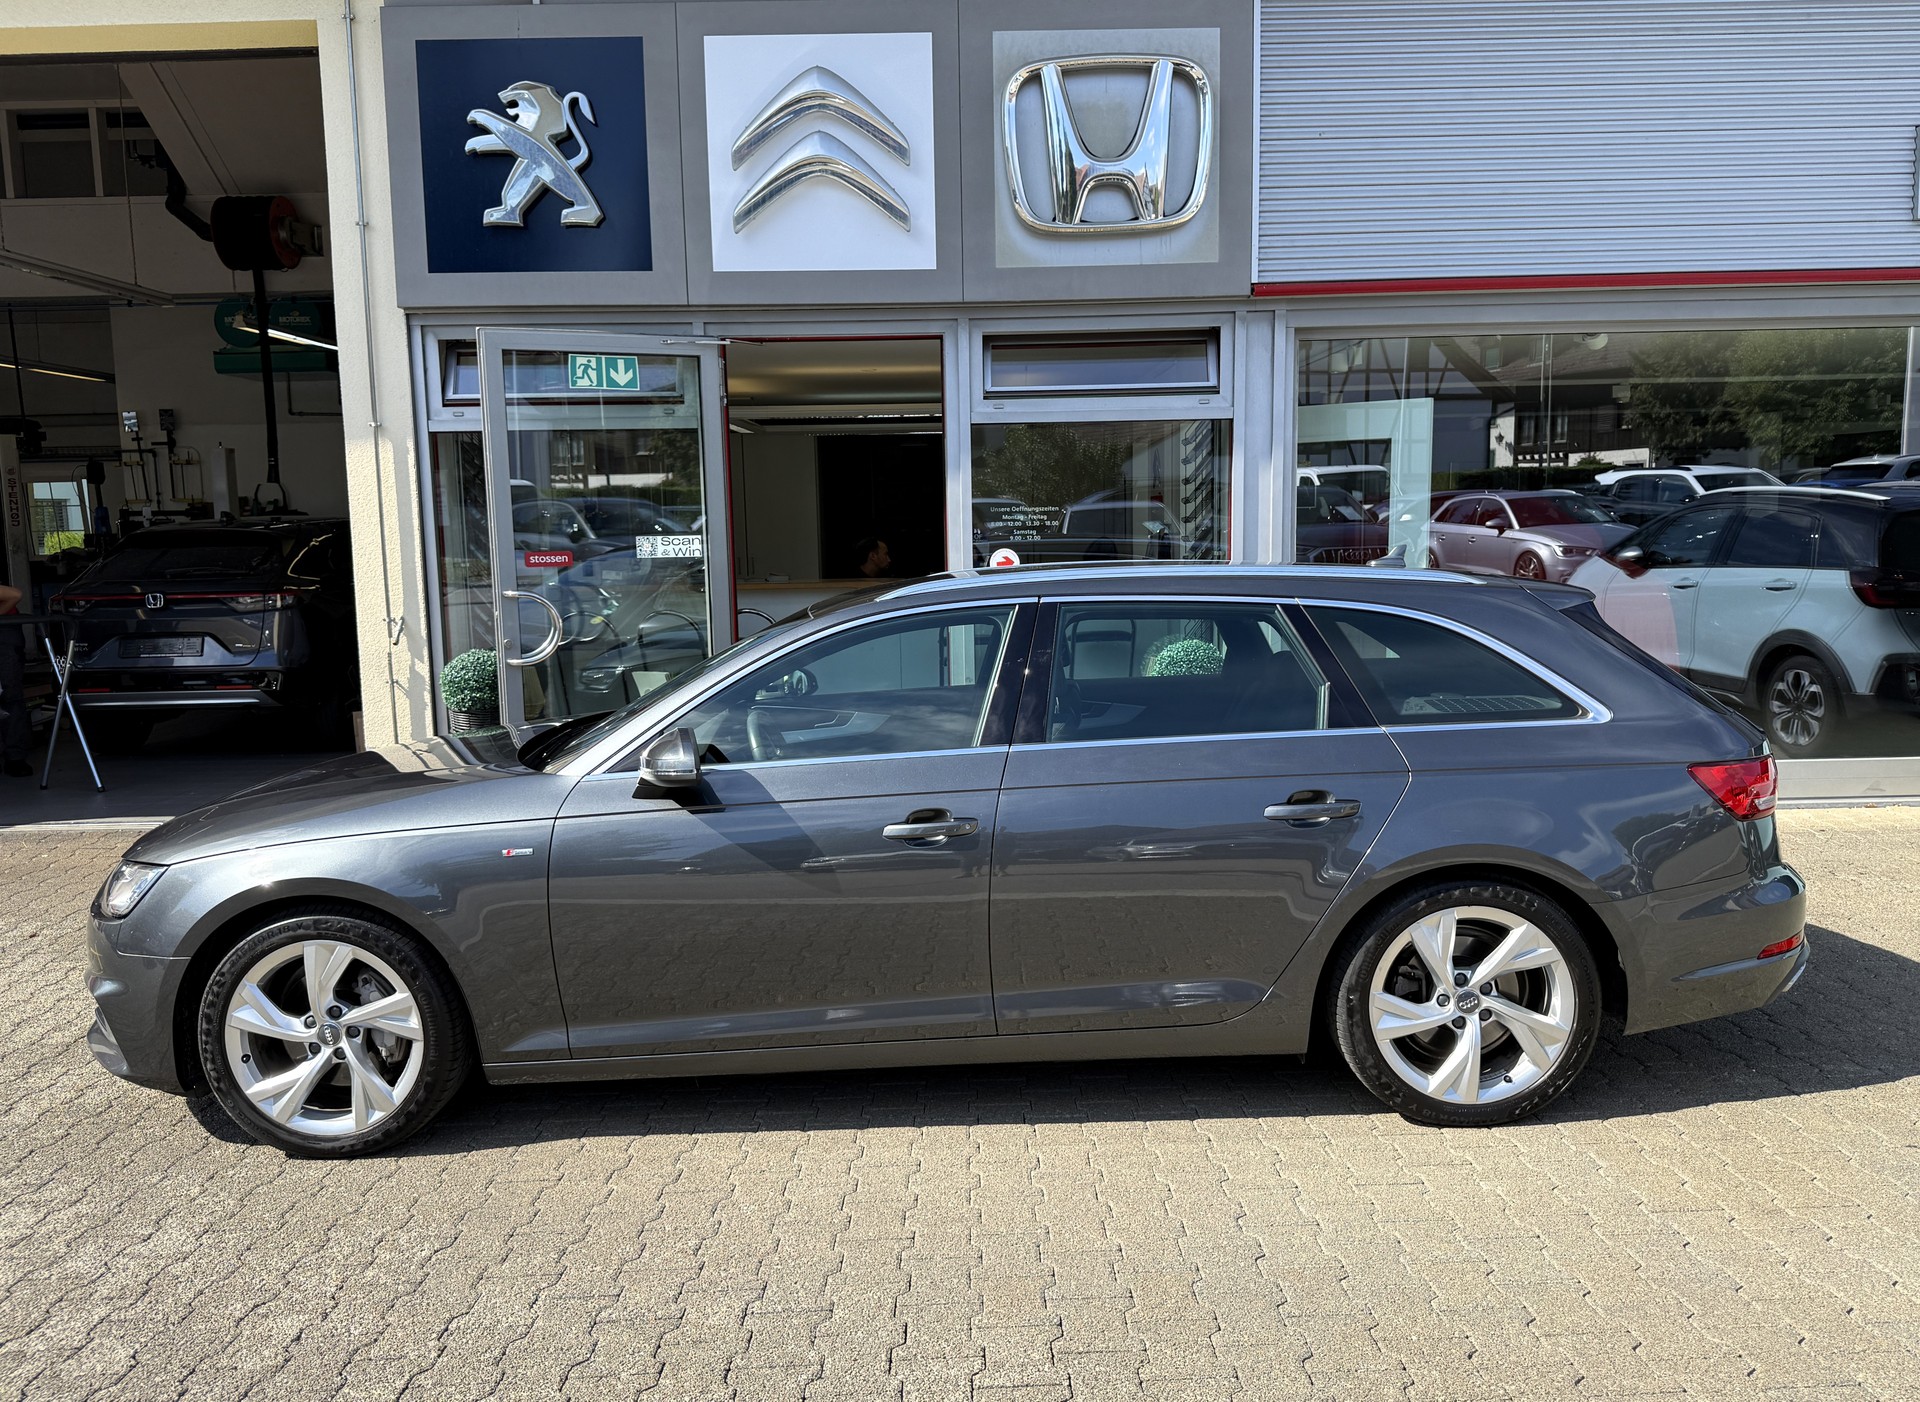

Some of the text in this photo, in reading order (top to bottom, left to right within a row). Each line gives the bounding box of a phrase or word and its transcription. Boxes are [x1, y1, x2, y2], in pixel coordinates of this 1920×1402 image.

[1011, 505, 1059, 513] Oeffnungszeiten
[660, 536, 702, 547] Scan
[662, 547, 702, 557] & Win
[529, 554, 569, 564] stossen
